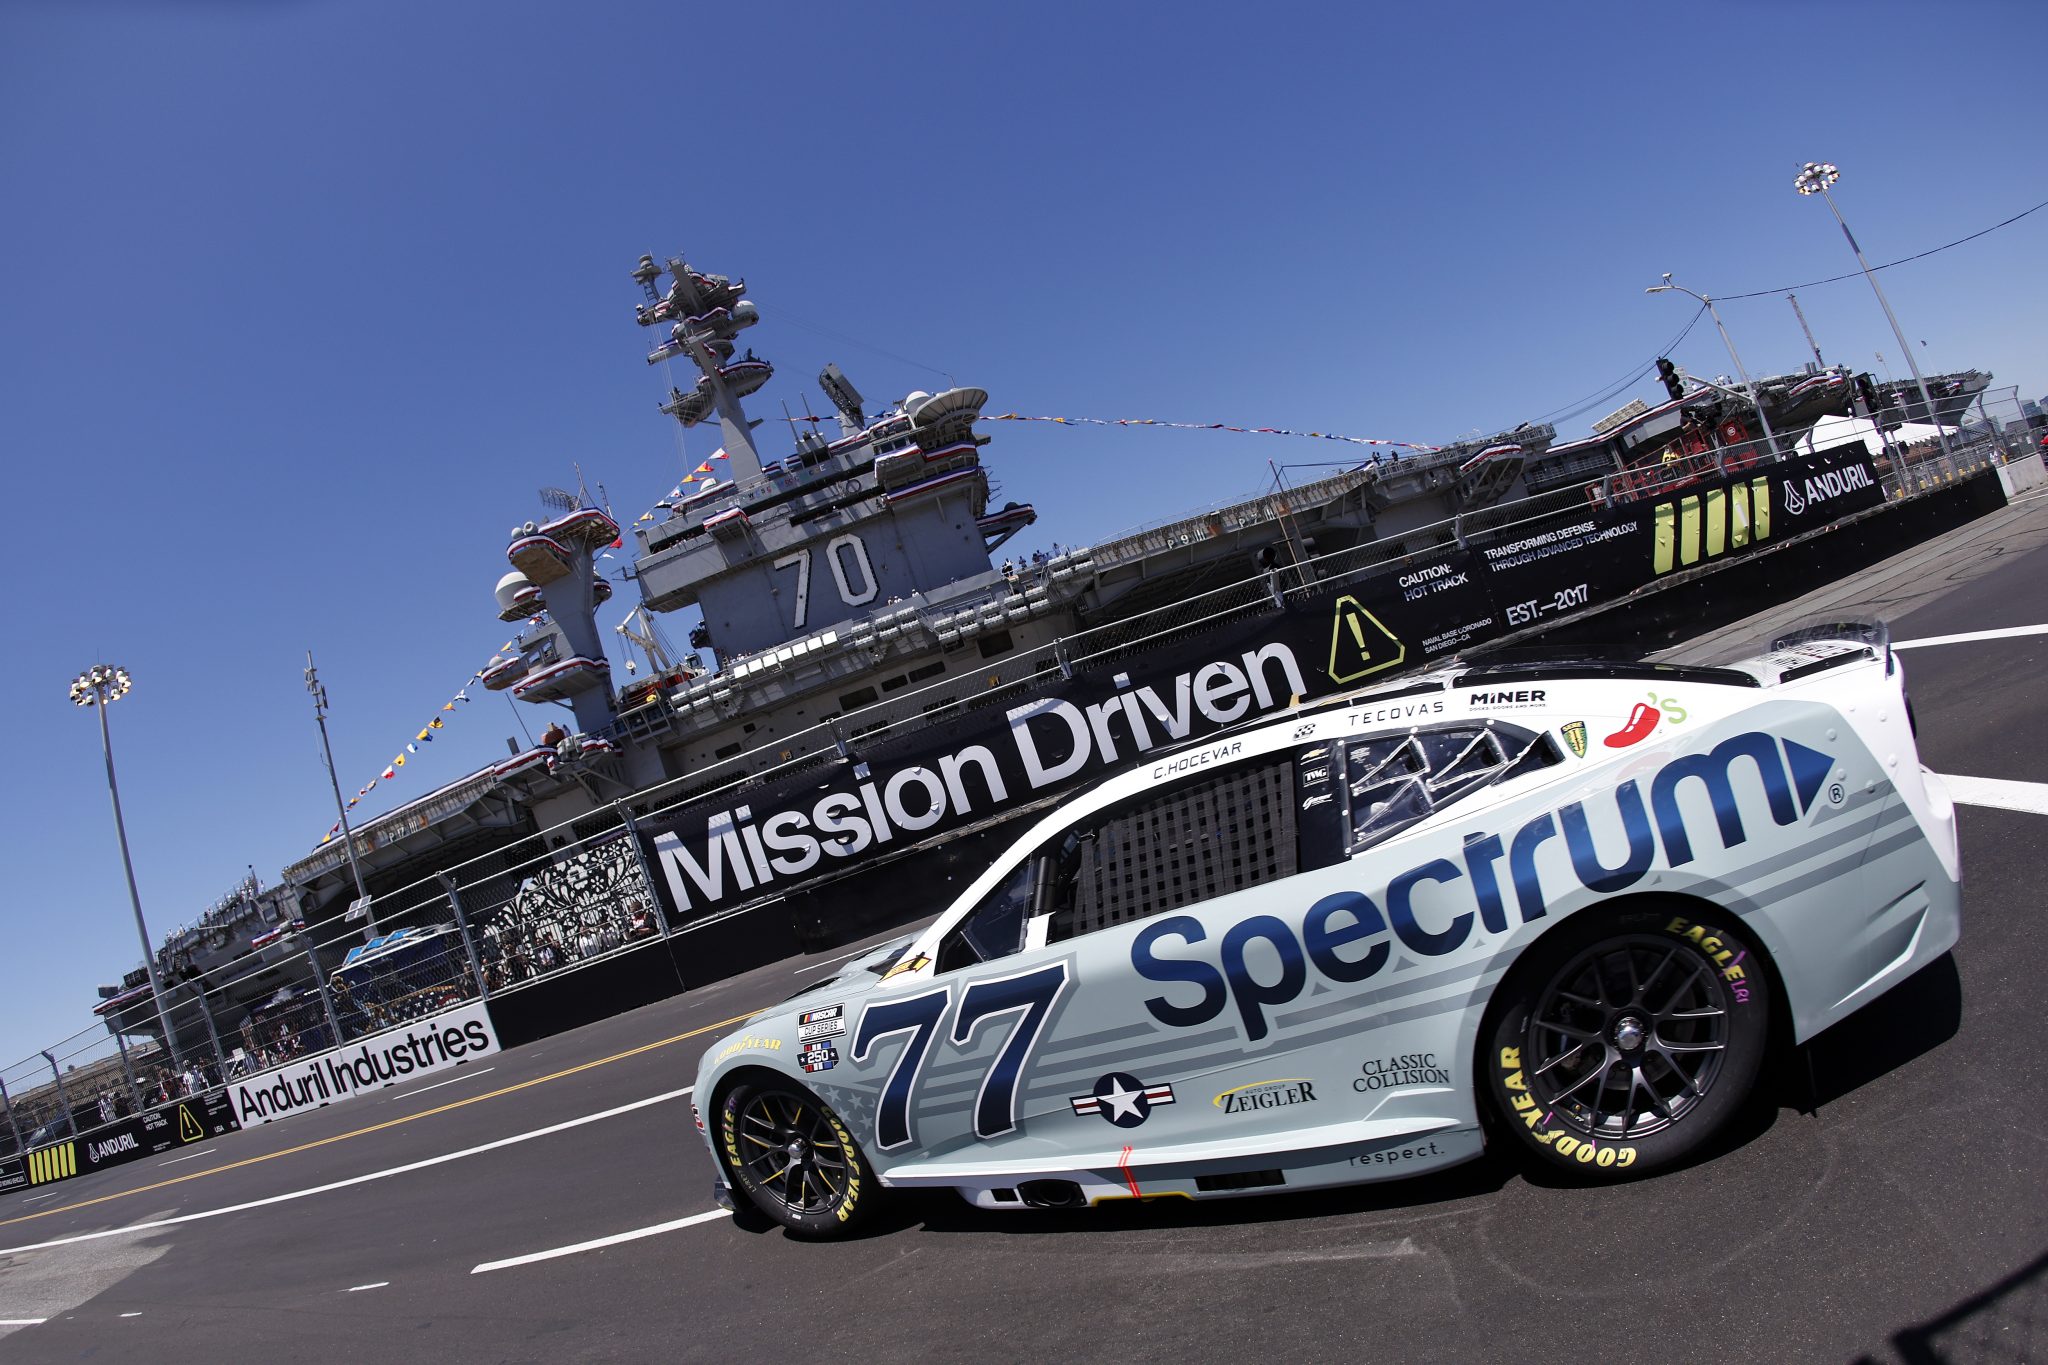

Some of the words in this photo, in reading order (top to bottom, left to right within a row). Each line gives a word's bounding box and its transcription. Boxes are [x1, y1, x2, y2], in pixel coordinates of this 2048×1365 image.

[1805, 463, 1874, 505] ANDURIL
[1180, 534, 1189, 545] 9
[1484, 530, 1558, 561] TRANSFORMING
[1555, 521, 1596, 541] DEFENSE
[1489, 551, 1537, 573] THROUGH
[1536, 538, 1584, 562] ADVANCED
[1583, 521, 1638, 546] TECHNOLOGY
[774, 532, 881, 629] 70
[1399, 563, 1453, 588] CAUTION:
[1404, 586, 1428, 602] HOT
[1429, 572, 1469, 595] TRACK
[1422, 635, 1442, 647] NAVAL
[1441, 629, 1458, 640] BASE
[1458, 617, 1492, 634] CORONADO
[1424, 644, 1439, 654] SAN
[1349, 701, 1445, 727] TECOVAS
[1153, 741, 1243, 780] C.HOCEVAR
[1304, 768, 1327, 781] TWG
[653, 744, 1009, 914] Mission
[1005, 641, 1308, 789] Driven
[1130, 730, 1799, 1043] Spectrum
[1665, 916, 1747, 982] EAGLE
[805, 1025, 816, 1036] CUP
[817, 1021, 838, 1033] SERIES
[811, 1007, 838, 1022] NASCAR
[807, 1049, 829, 1064] 250
[850, 959, 1070, 1151] 77
[1362, 1053, 1437, 1076] CLASSIC
[239, 1061, 331, 1122] Anduril
[325, 1019, 489, 1095] Industries
[1353, 1069, 1450, 1092] COLLISION
[1221, 1081, 1318, 1114] ZEIGLER
[1500, 1046, 1637, 1168] GOODYEAR
[213, 1124, 225, 1133] USA
[724, 1109, 743, 1167] EAGLE
[98, 1132, 139, 1158] ANDURIL
[1348, 1142, 1446, 1166] respect.
[821, 1105, 861, 1222] GOODYEAR
